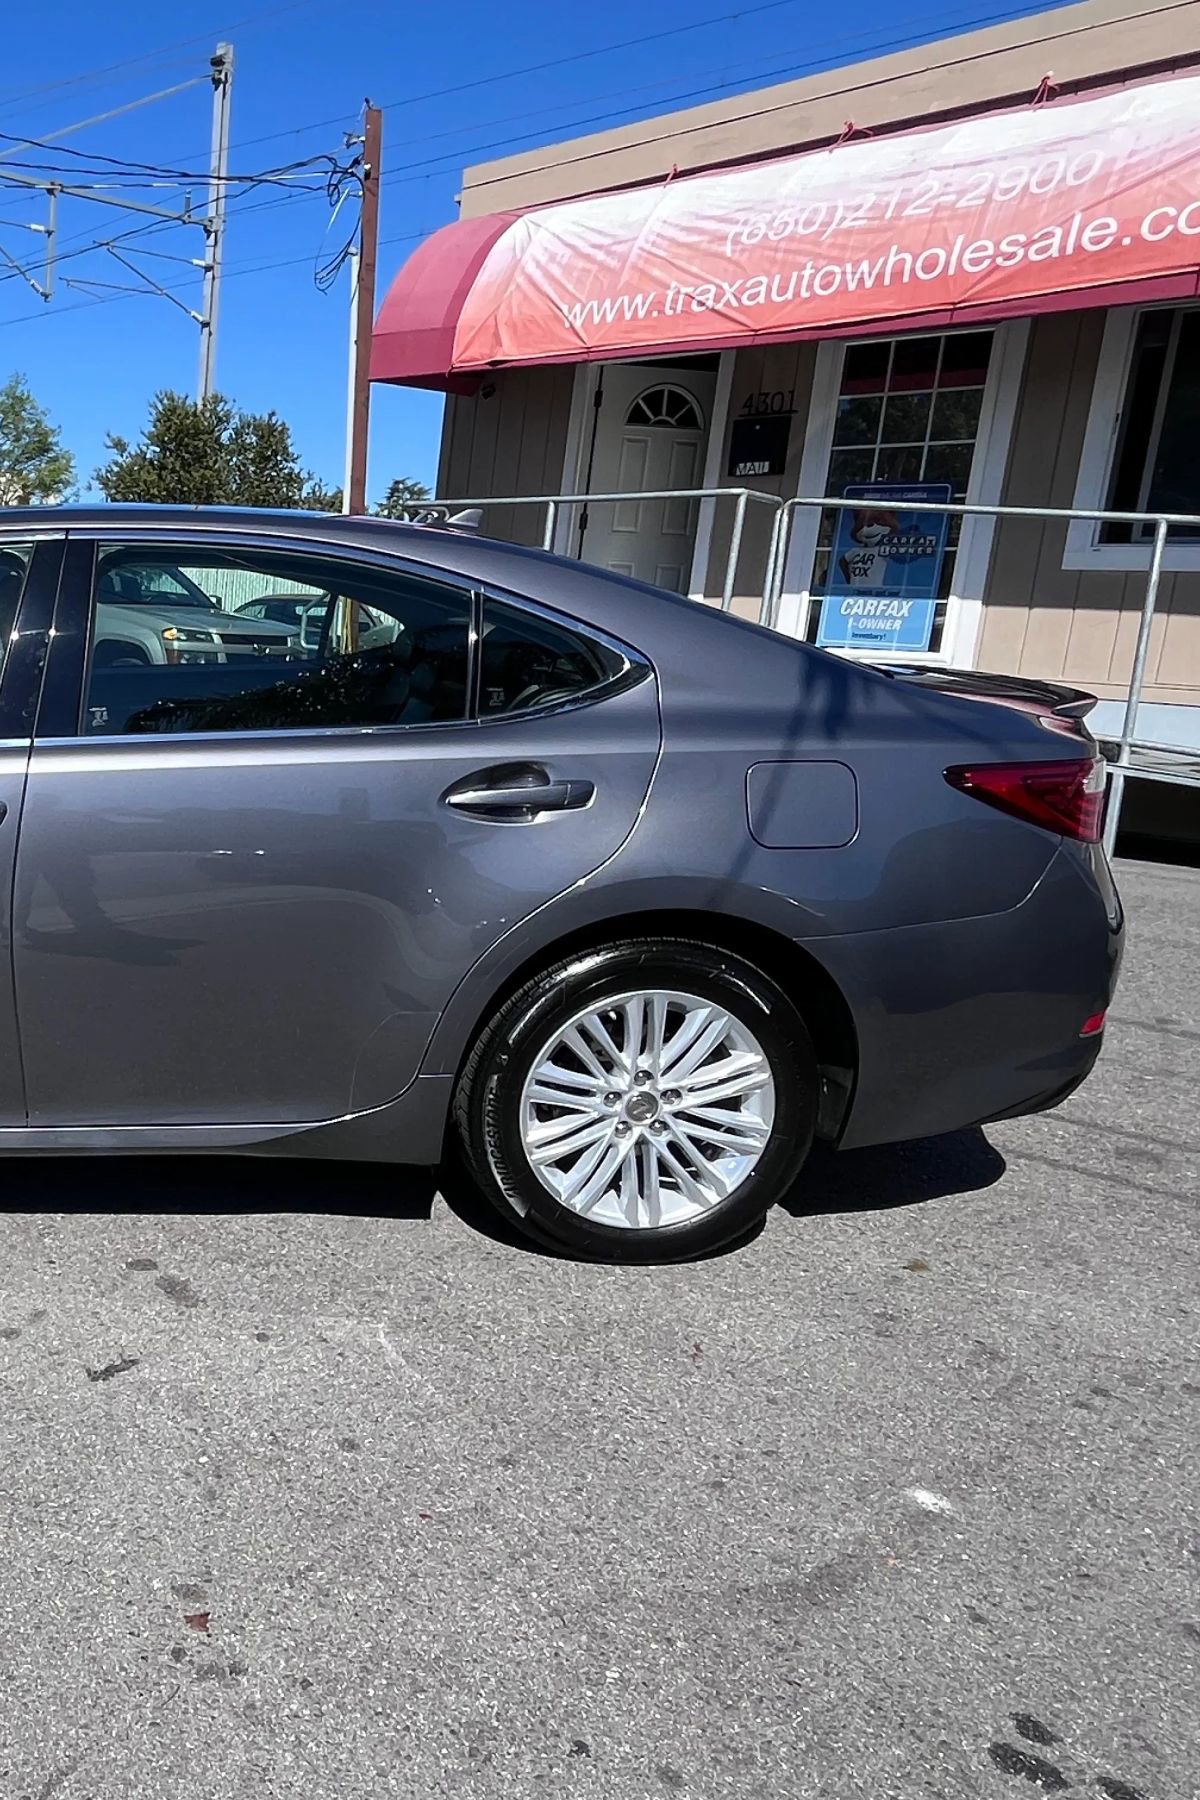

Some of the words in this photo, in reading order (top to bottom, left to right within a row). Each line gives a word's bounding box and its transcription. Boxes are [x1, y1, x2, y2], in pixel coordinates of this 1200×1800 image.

[724, 150, 1104, 256] (650)212-2900
[742, 391, 796, 415] 4301
[840, 599, 913, 617] CARFAX
[847, 617, 902, 631] 1-OWNER
